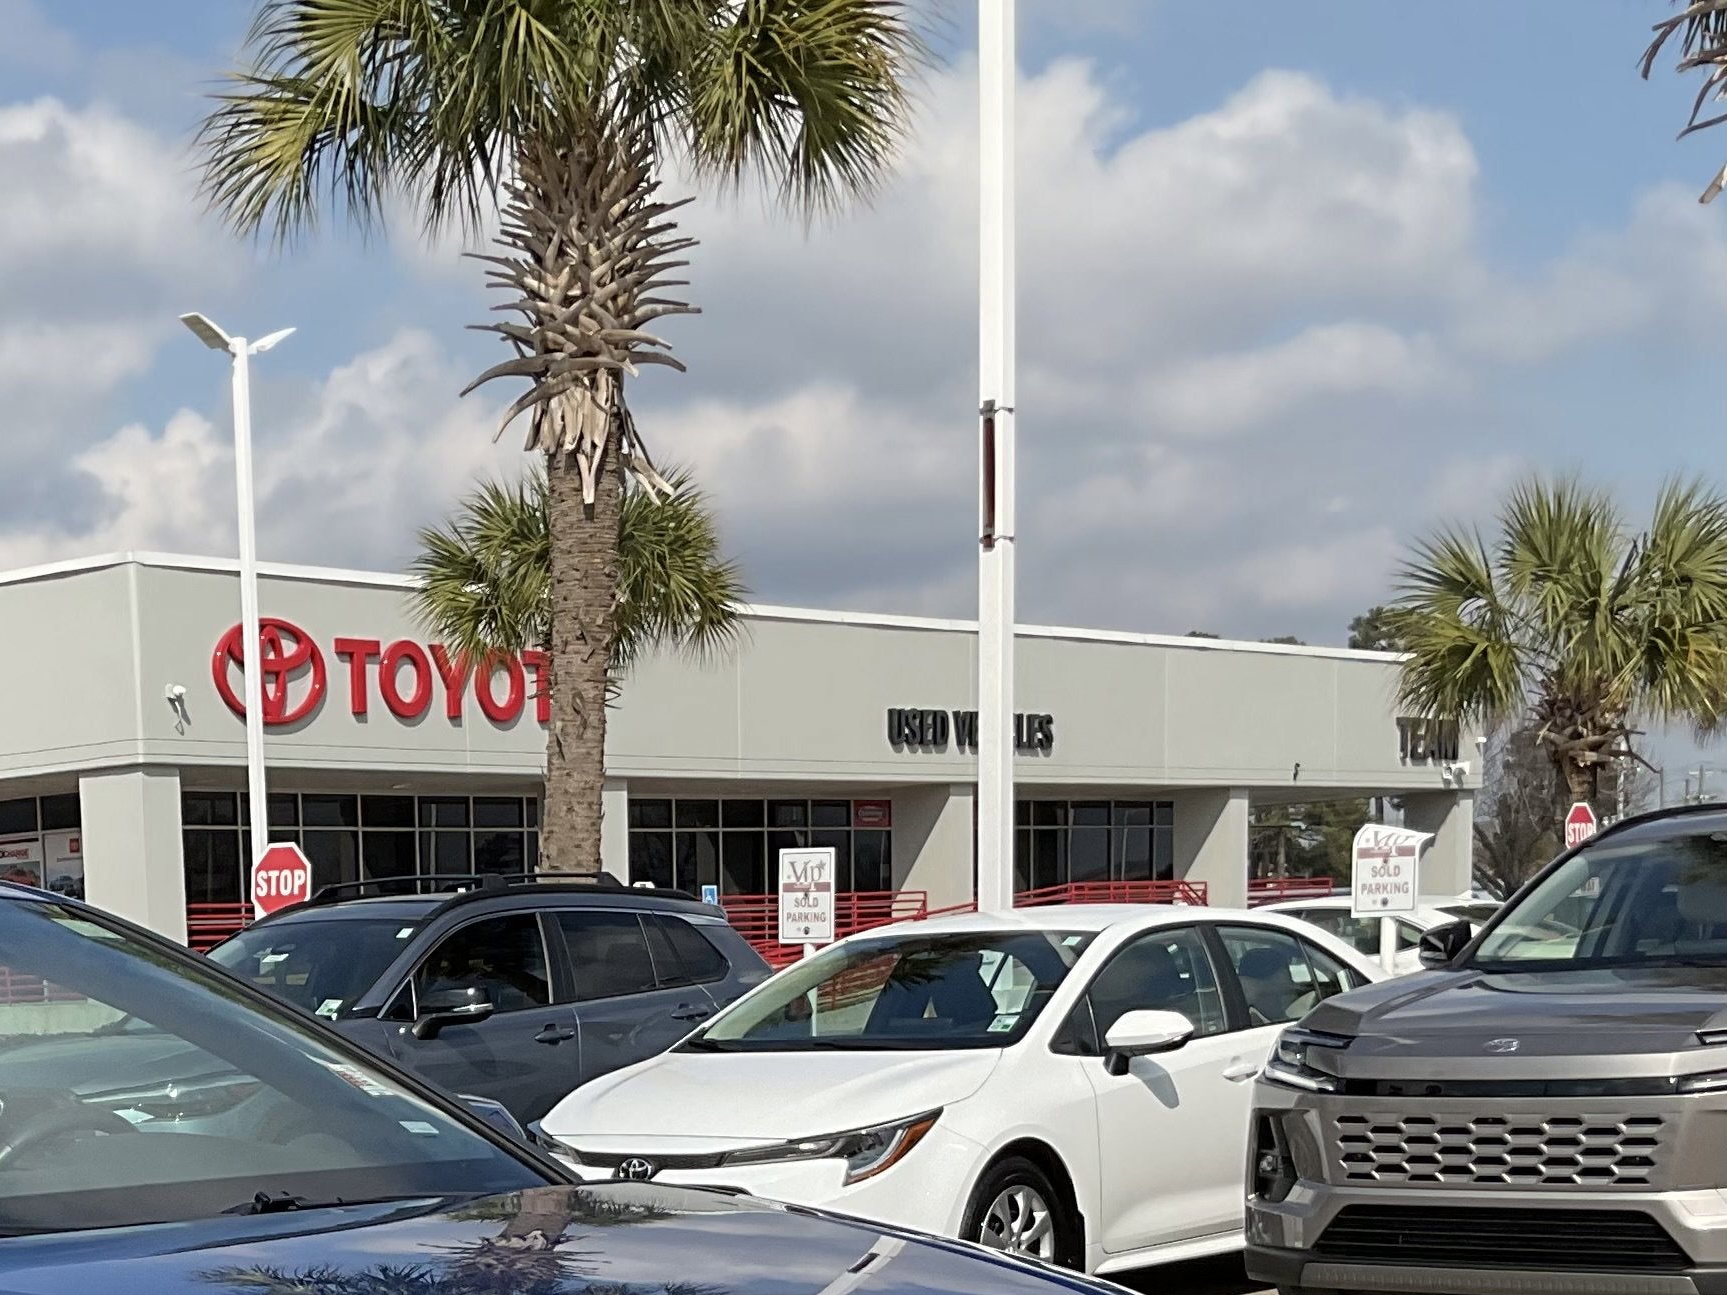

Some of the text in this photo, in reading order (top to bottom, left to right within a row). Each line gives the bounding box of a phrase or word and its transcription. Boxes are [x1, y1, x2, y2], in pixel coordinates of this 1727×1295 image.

[334, 637, 555, 722] TOYOT
[887, 708, 1054, 749] USED VELES
[1568, 823, 1594, 843] STOP
[1371, 865, 1401, 878] SOLD
[256, 869, 306, 897] STOP
[1361, 882, 1409, 895] PARKING
[794, 896, 819, 908] SOLD
[786, 911, 826, 923] PARKING
